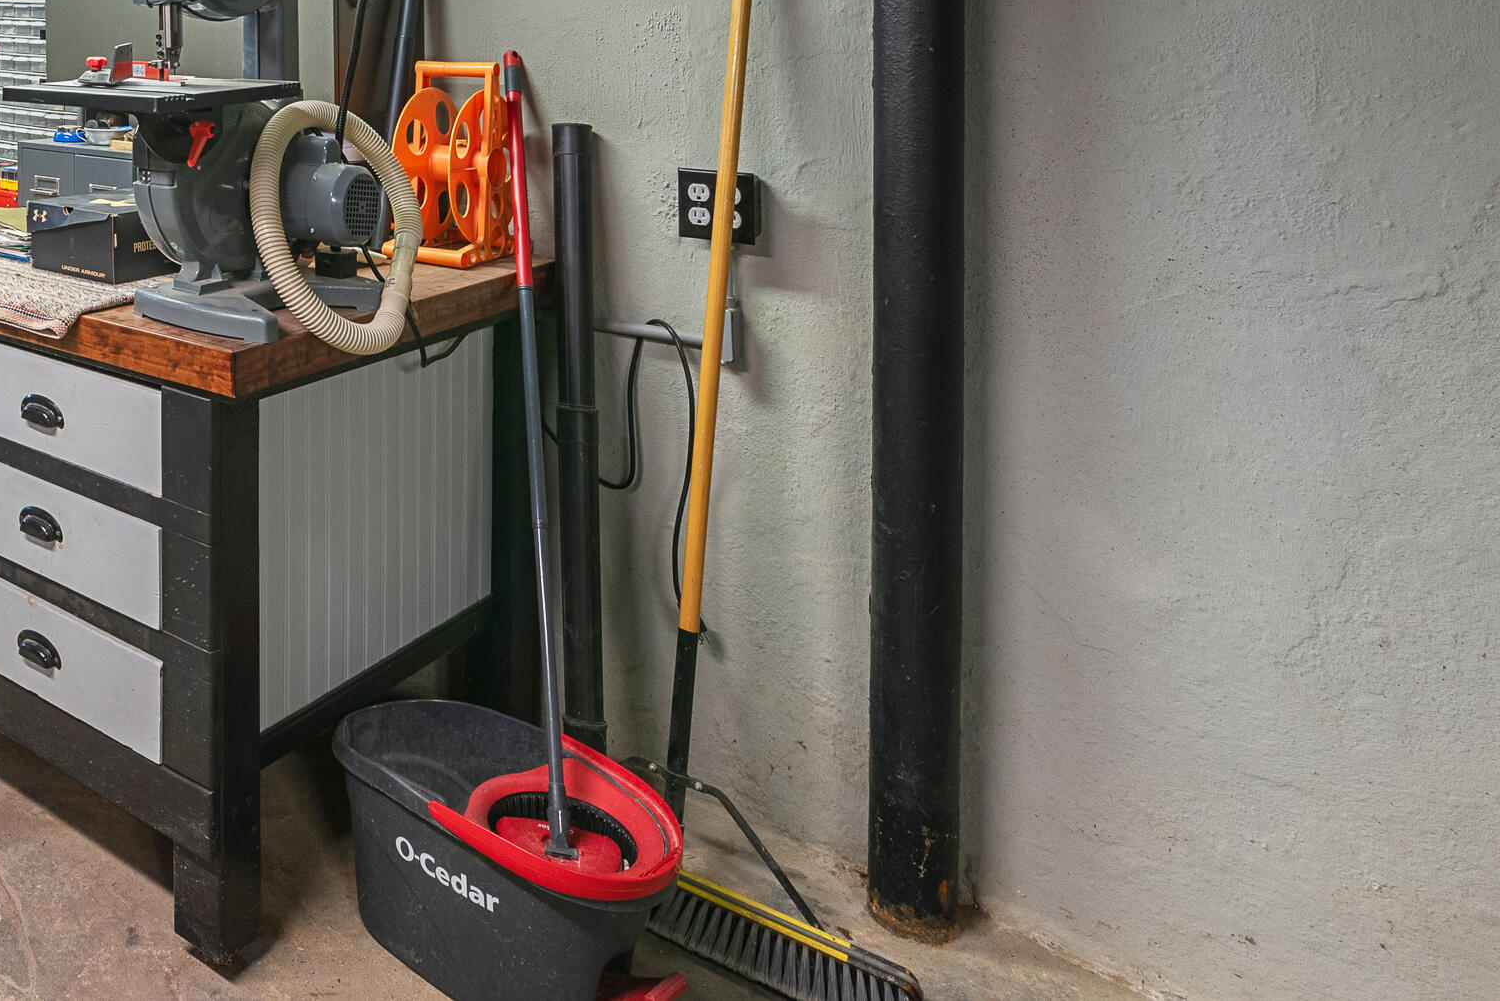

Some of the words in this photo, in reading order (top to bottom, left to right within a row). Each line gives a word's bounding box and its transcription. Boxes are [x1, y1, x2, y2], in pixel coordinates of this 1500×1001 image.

[61, 264, 80, 273] UNDER
[81, 268, 106, 278] ARMOUR
[395, 836, 500, 913] O-Cedar
